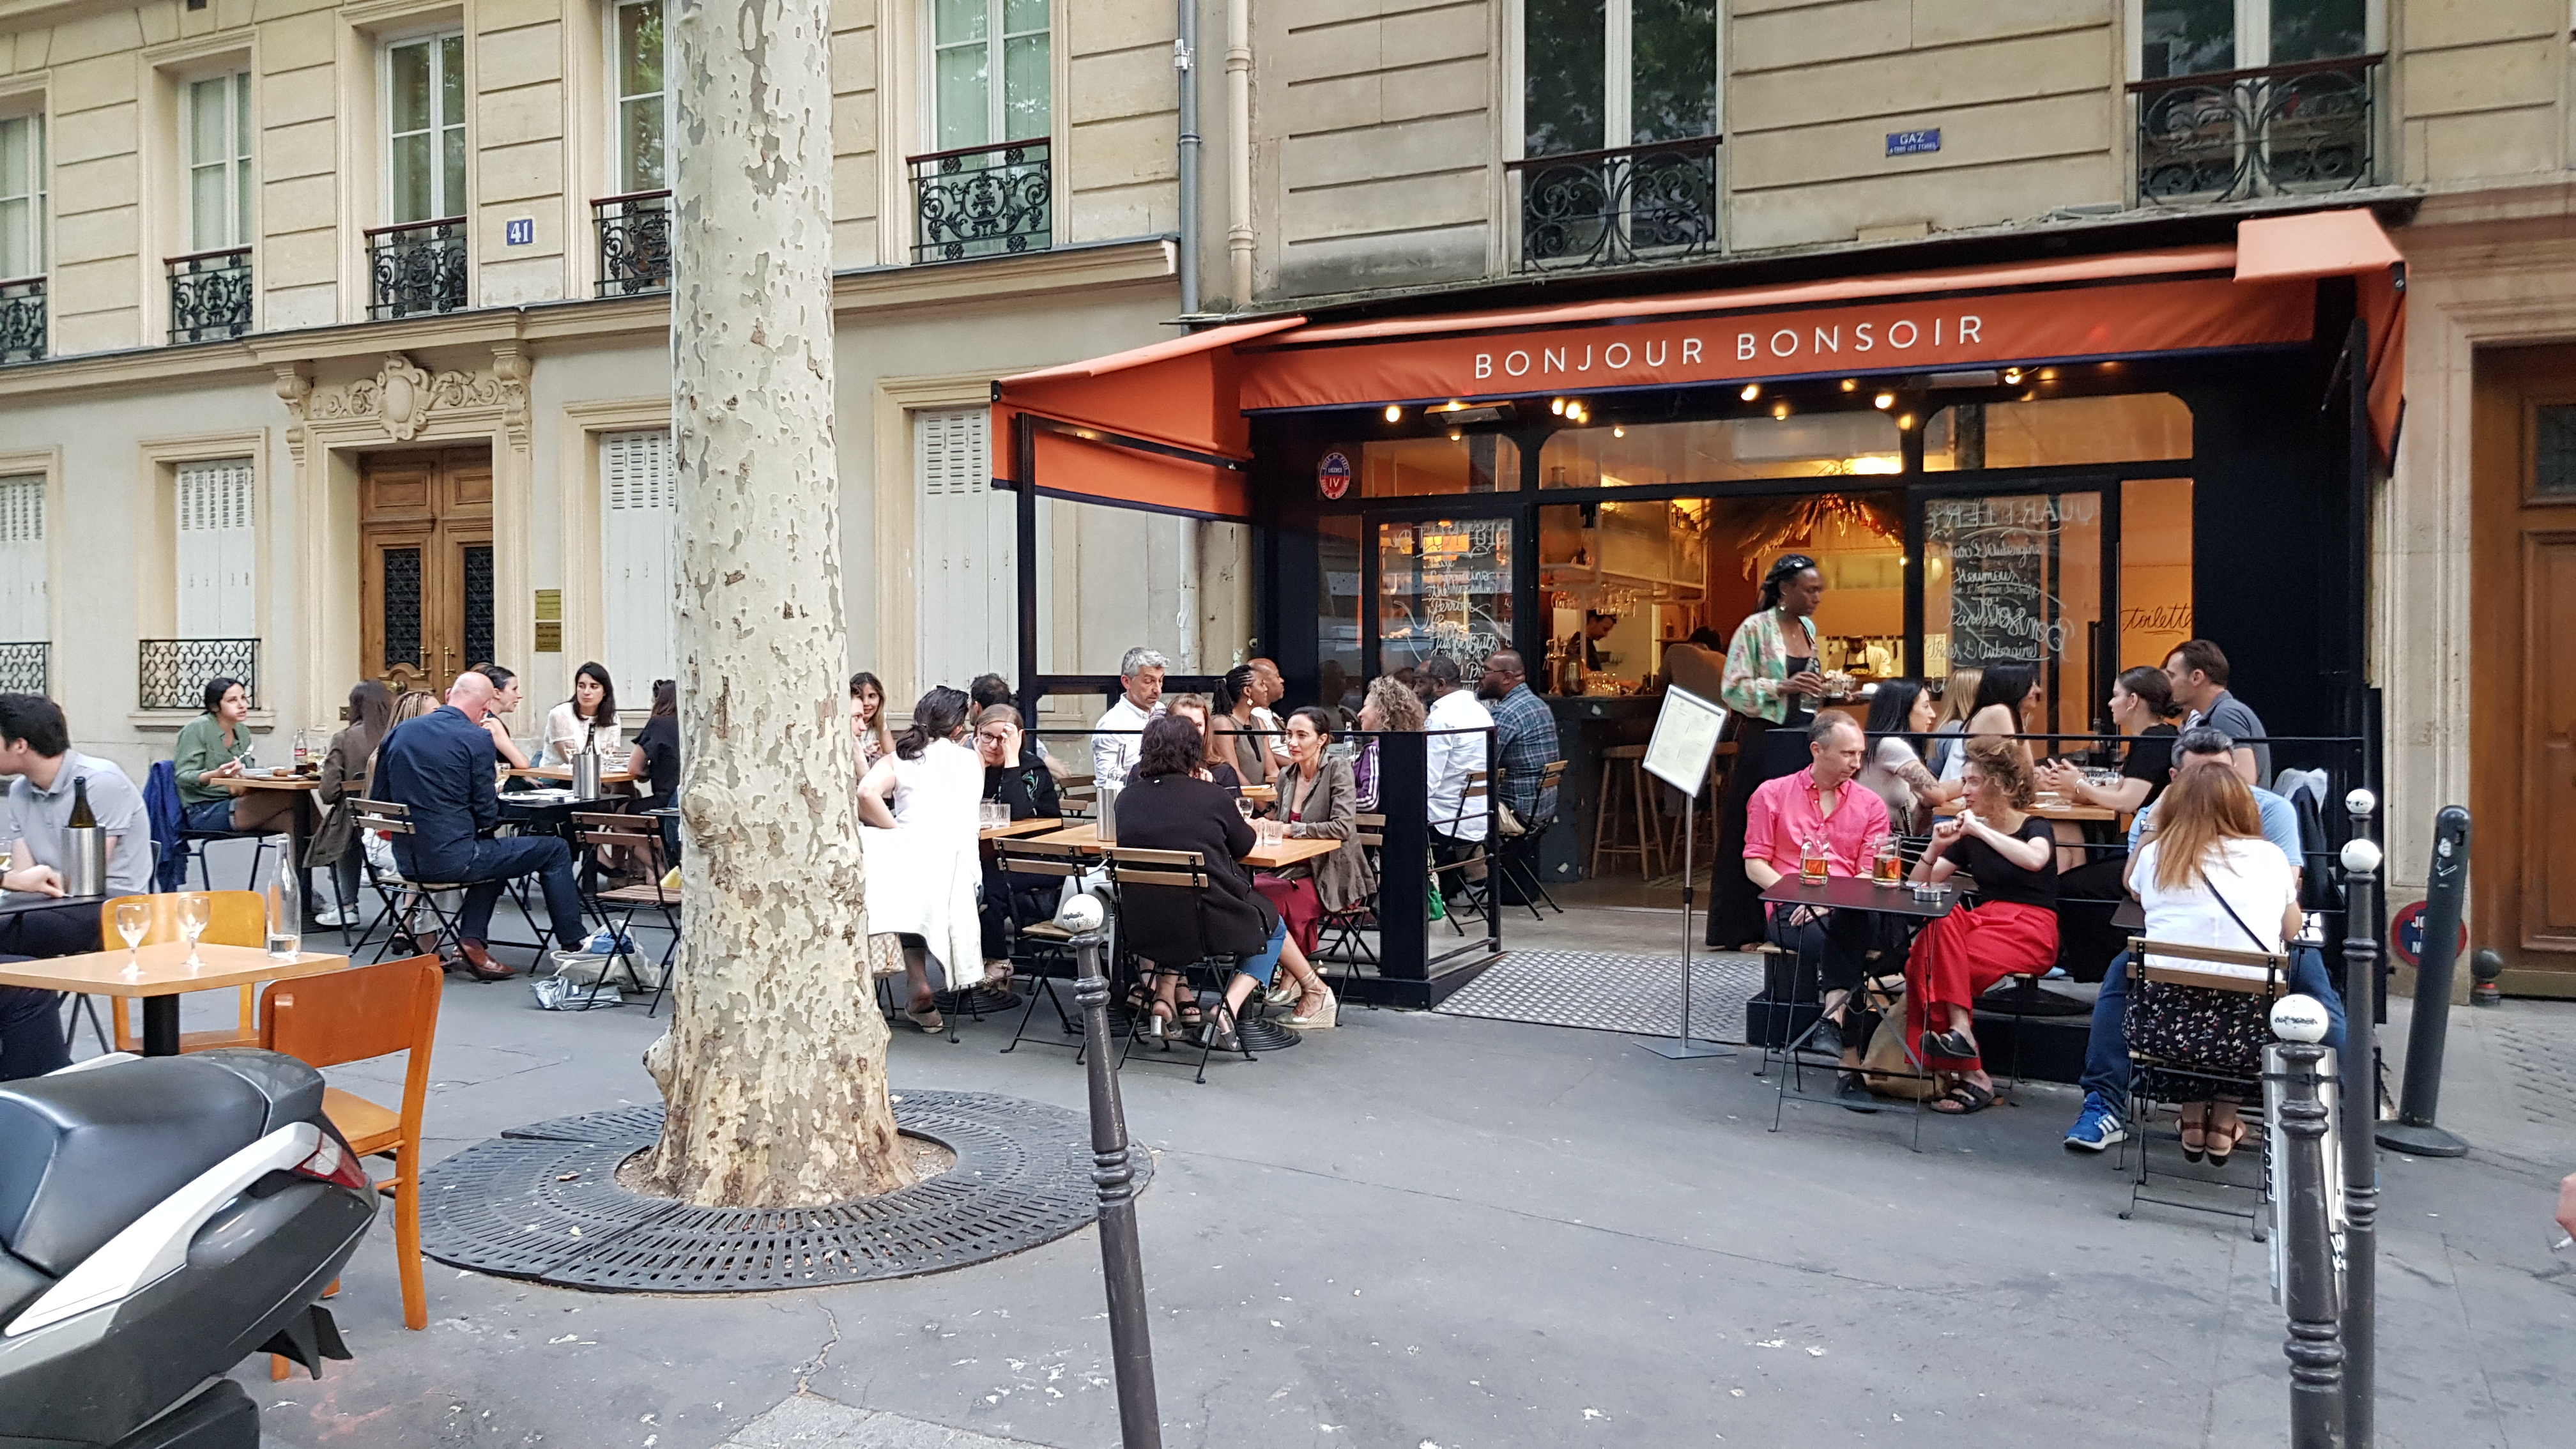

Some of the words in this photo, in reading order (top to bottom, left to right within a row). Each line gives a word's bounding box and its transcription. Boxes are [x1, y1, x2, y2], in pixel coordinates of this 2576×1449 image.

[1900, 132, 1925, 145] GAZ
[510, 221, 529, 243] 41
[1475, 337, 1703, 379] BONJOUR
[1737, 315, 1982, 362] BONSOIR
[1329, 477, 1340, 487] IV
